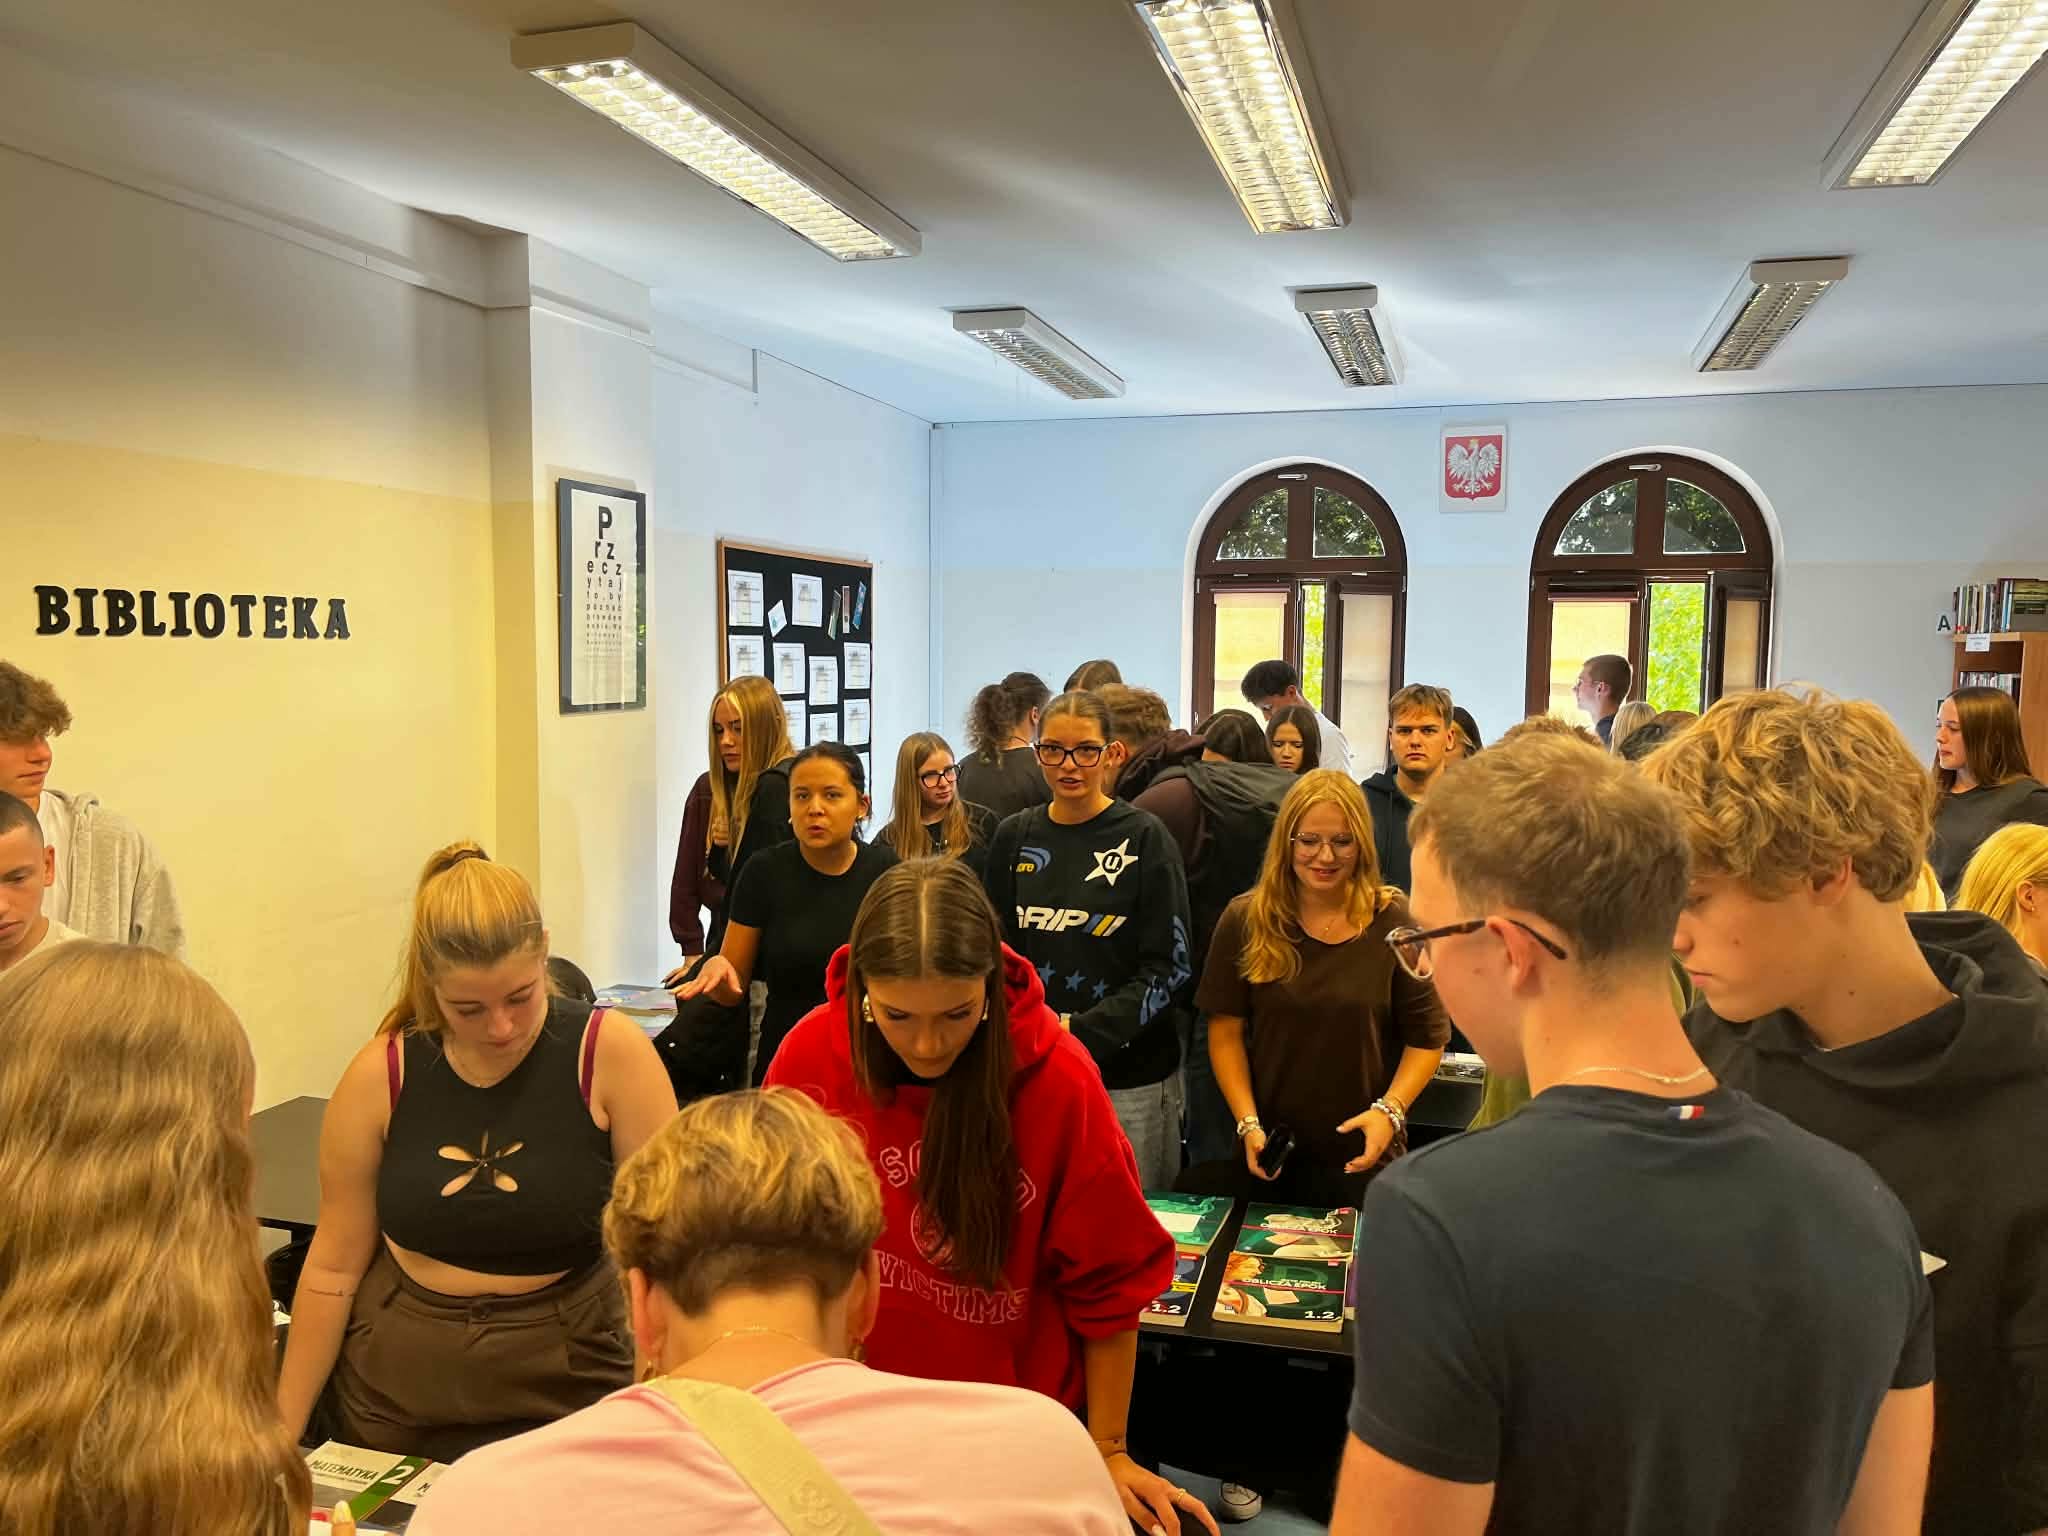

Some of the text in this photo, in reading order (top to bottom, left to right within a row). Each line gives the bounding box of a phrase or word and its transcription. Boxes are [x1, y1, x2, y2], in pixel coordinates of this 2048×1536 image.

[598, 506, 612, 539] P
[34, 585, 350, 639] BIBLIOTEKA
[1937, 615, 1951, 631] A
[1152, 1303, 1181, 1314] 1.2
[1304, 1310, 1335, 1319] 1.2
[311, 1460, 378, 1480] MATEMATYKA
[381, 1465, 415, 1485] 2
